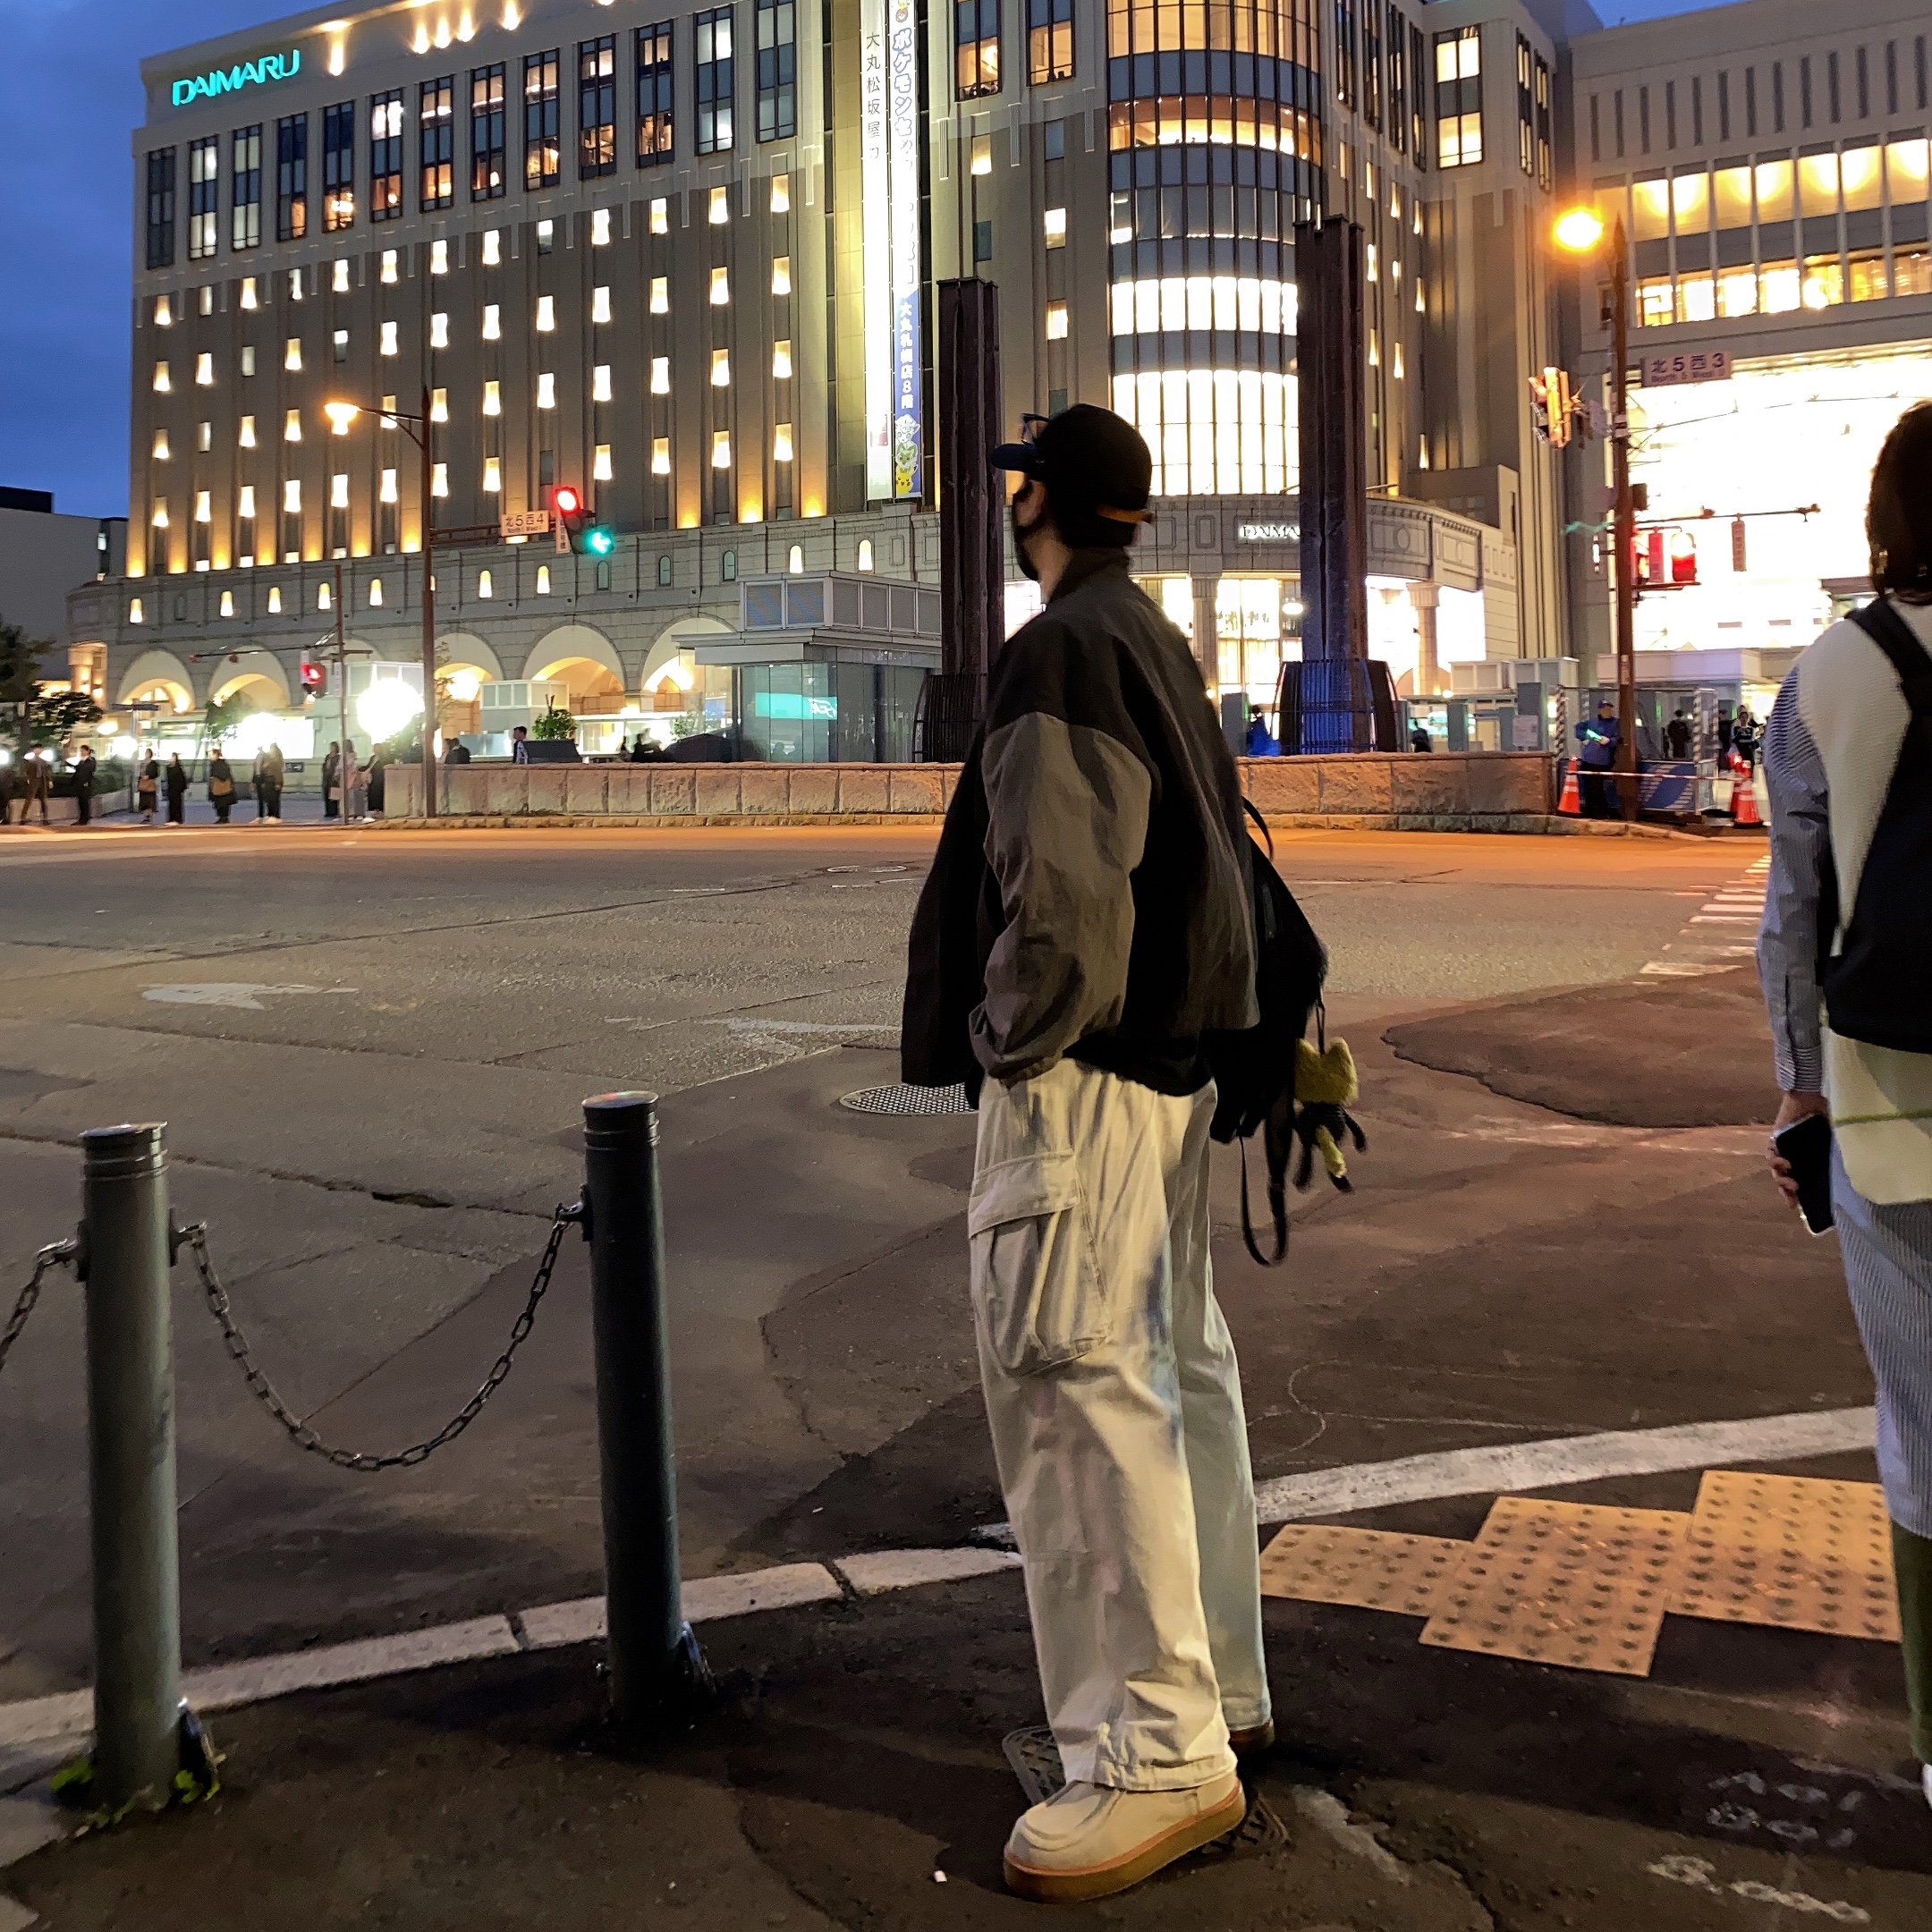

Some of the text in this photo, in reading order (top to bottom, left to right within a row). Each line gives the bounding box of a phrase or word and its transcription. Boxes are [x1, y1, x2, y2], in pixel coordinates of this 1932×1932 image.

[172, 48, 301, 106] DAIMARU
[1650, 352, 1724, 374] 北5西3
[505, 513, 544, 528] 北5西4
[1241, 525, 1301, 538] DAIMA
